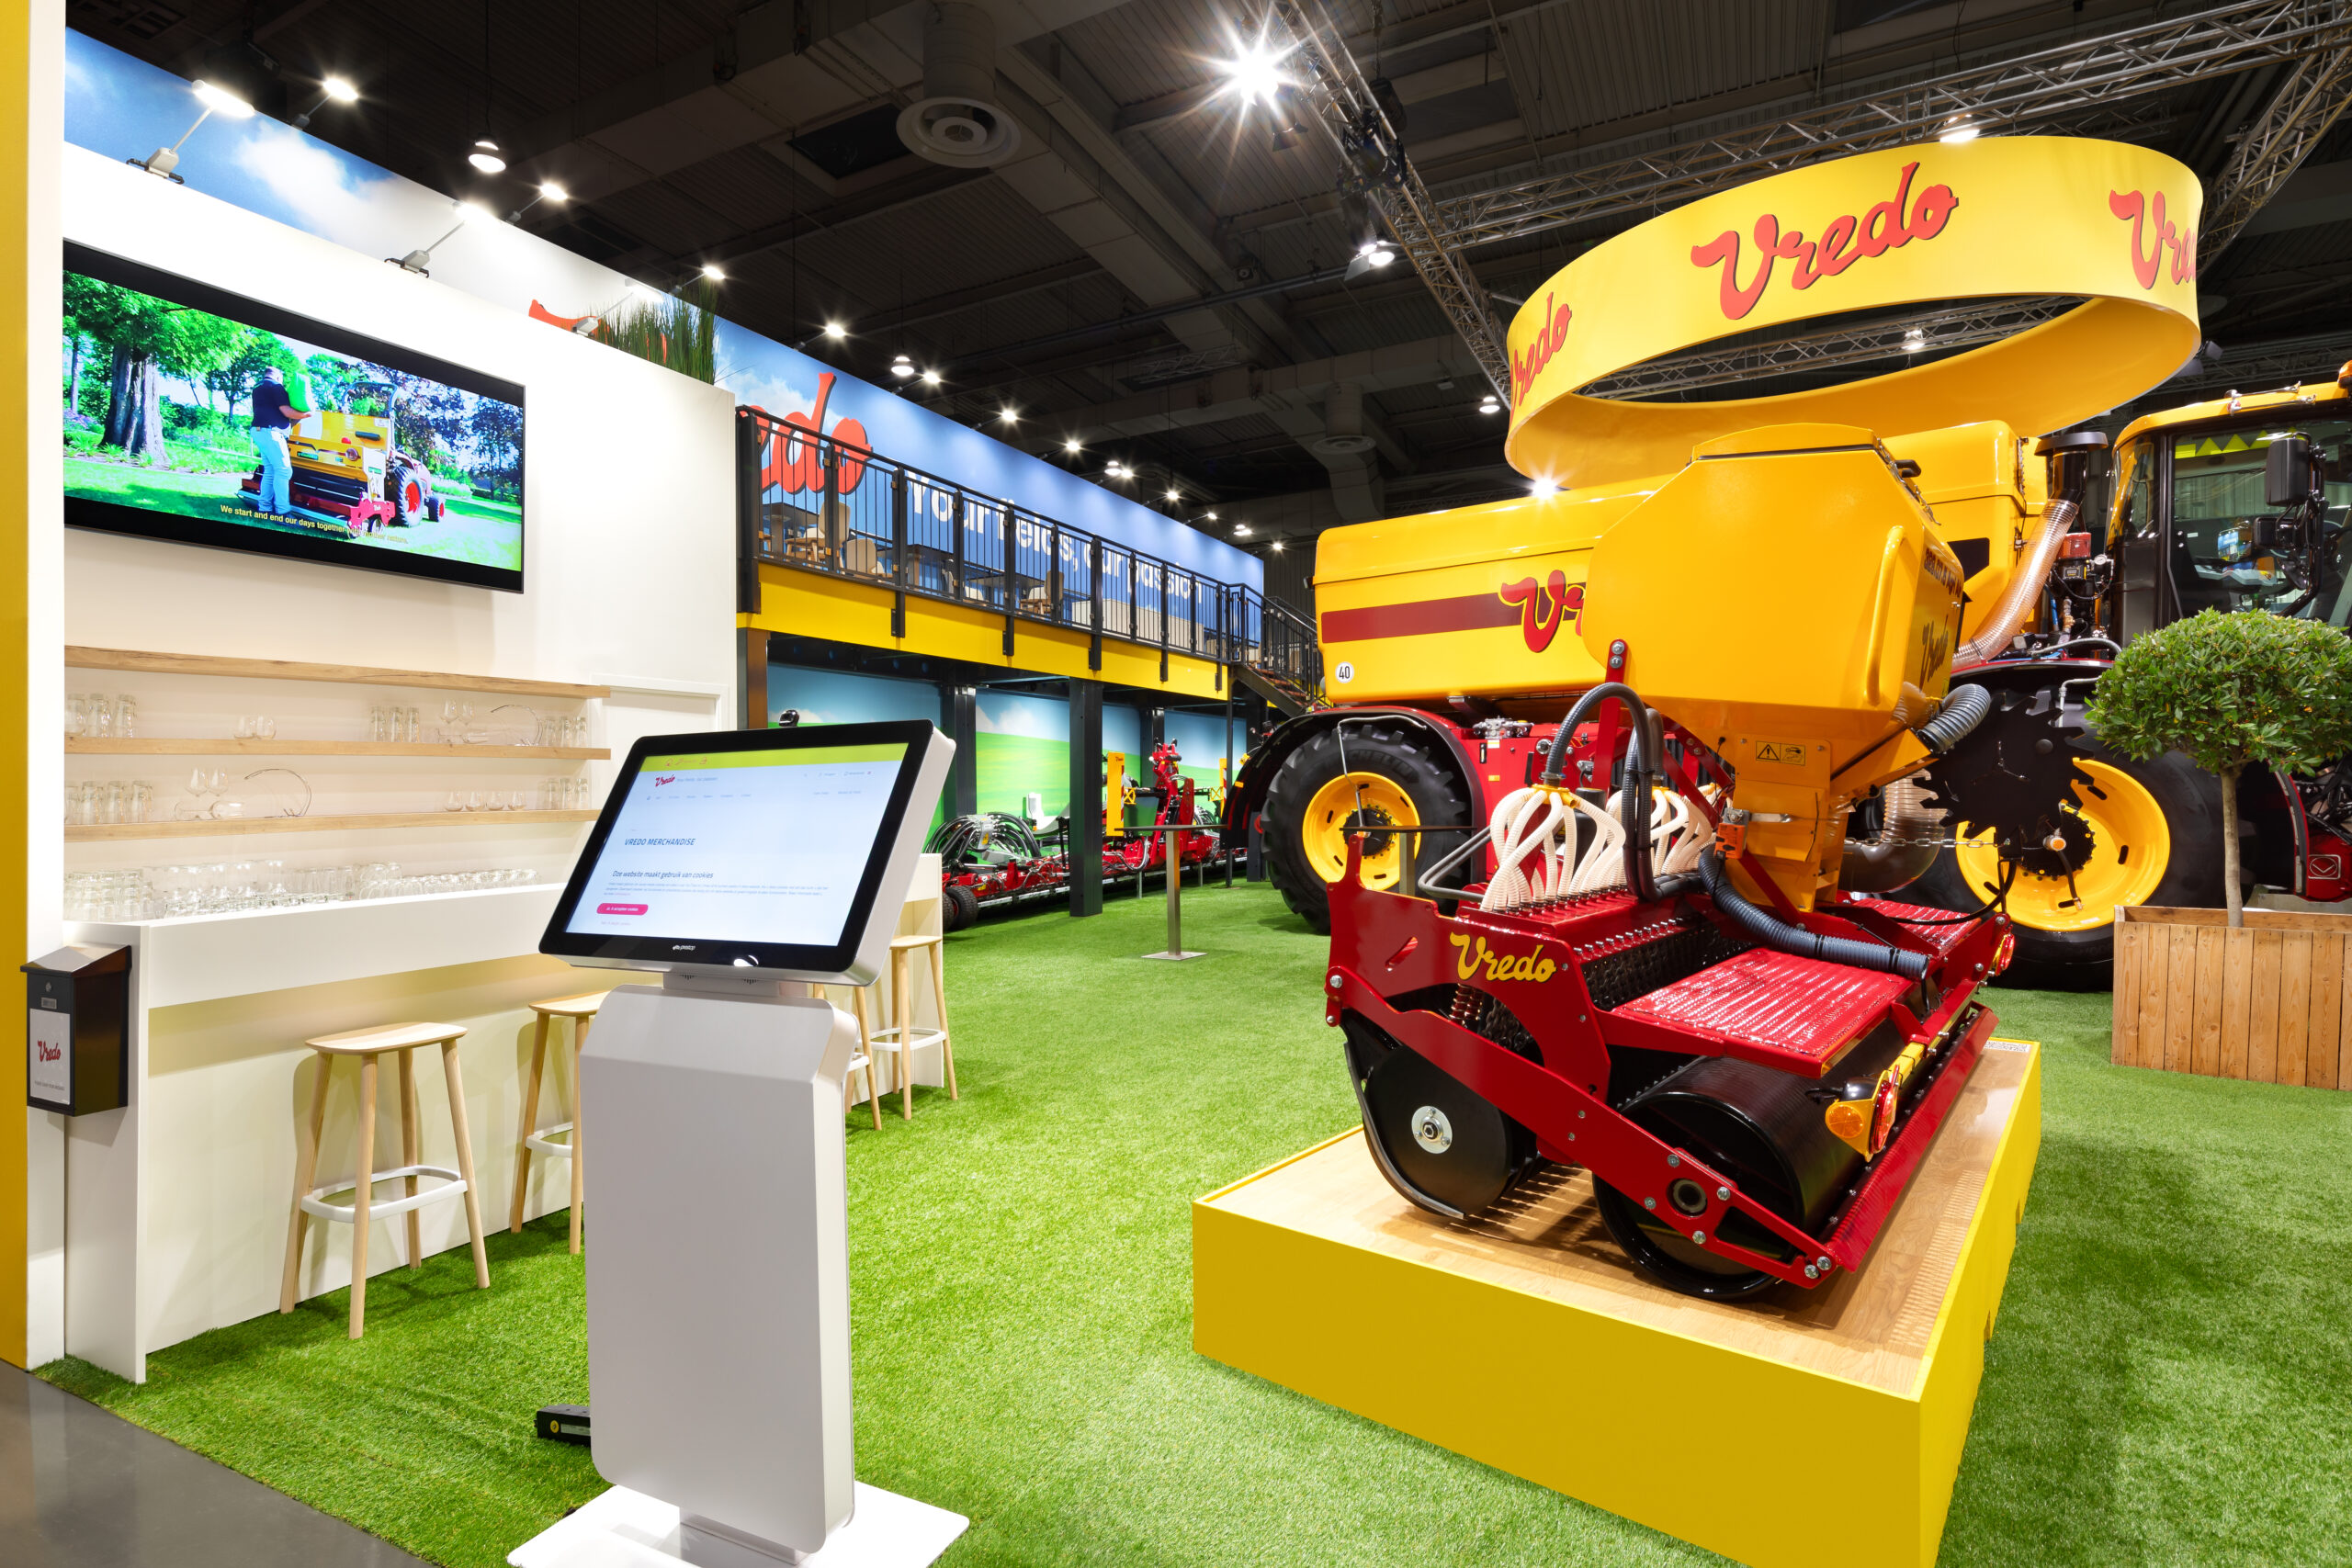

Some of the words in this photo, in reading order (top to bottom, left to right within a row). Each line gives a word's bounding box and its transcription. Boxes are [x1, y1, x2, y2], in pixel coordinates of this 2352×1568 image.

[1690, 162, 1959, 320] Vredo
[220, 504, 232, 513] We
[234, 508, 252, 517] start
[299, 518, 315, 528] days
[317, 522, 345, 533] together
[996, 497, 1079, 572] felds,
[1339, 666, 1351, 679] 40
[647, 838, 695, 846] MERCHANDISE
[1450, 931, 1557, 982] Vredo
[38, 1040, 61, 1062] Vredo
